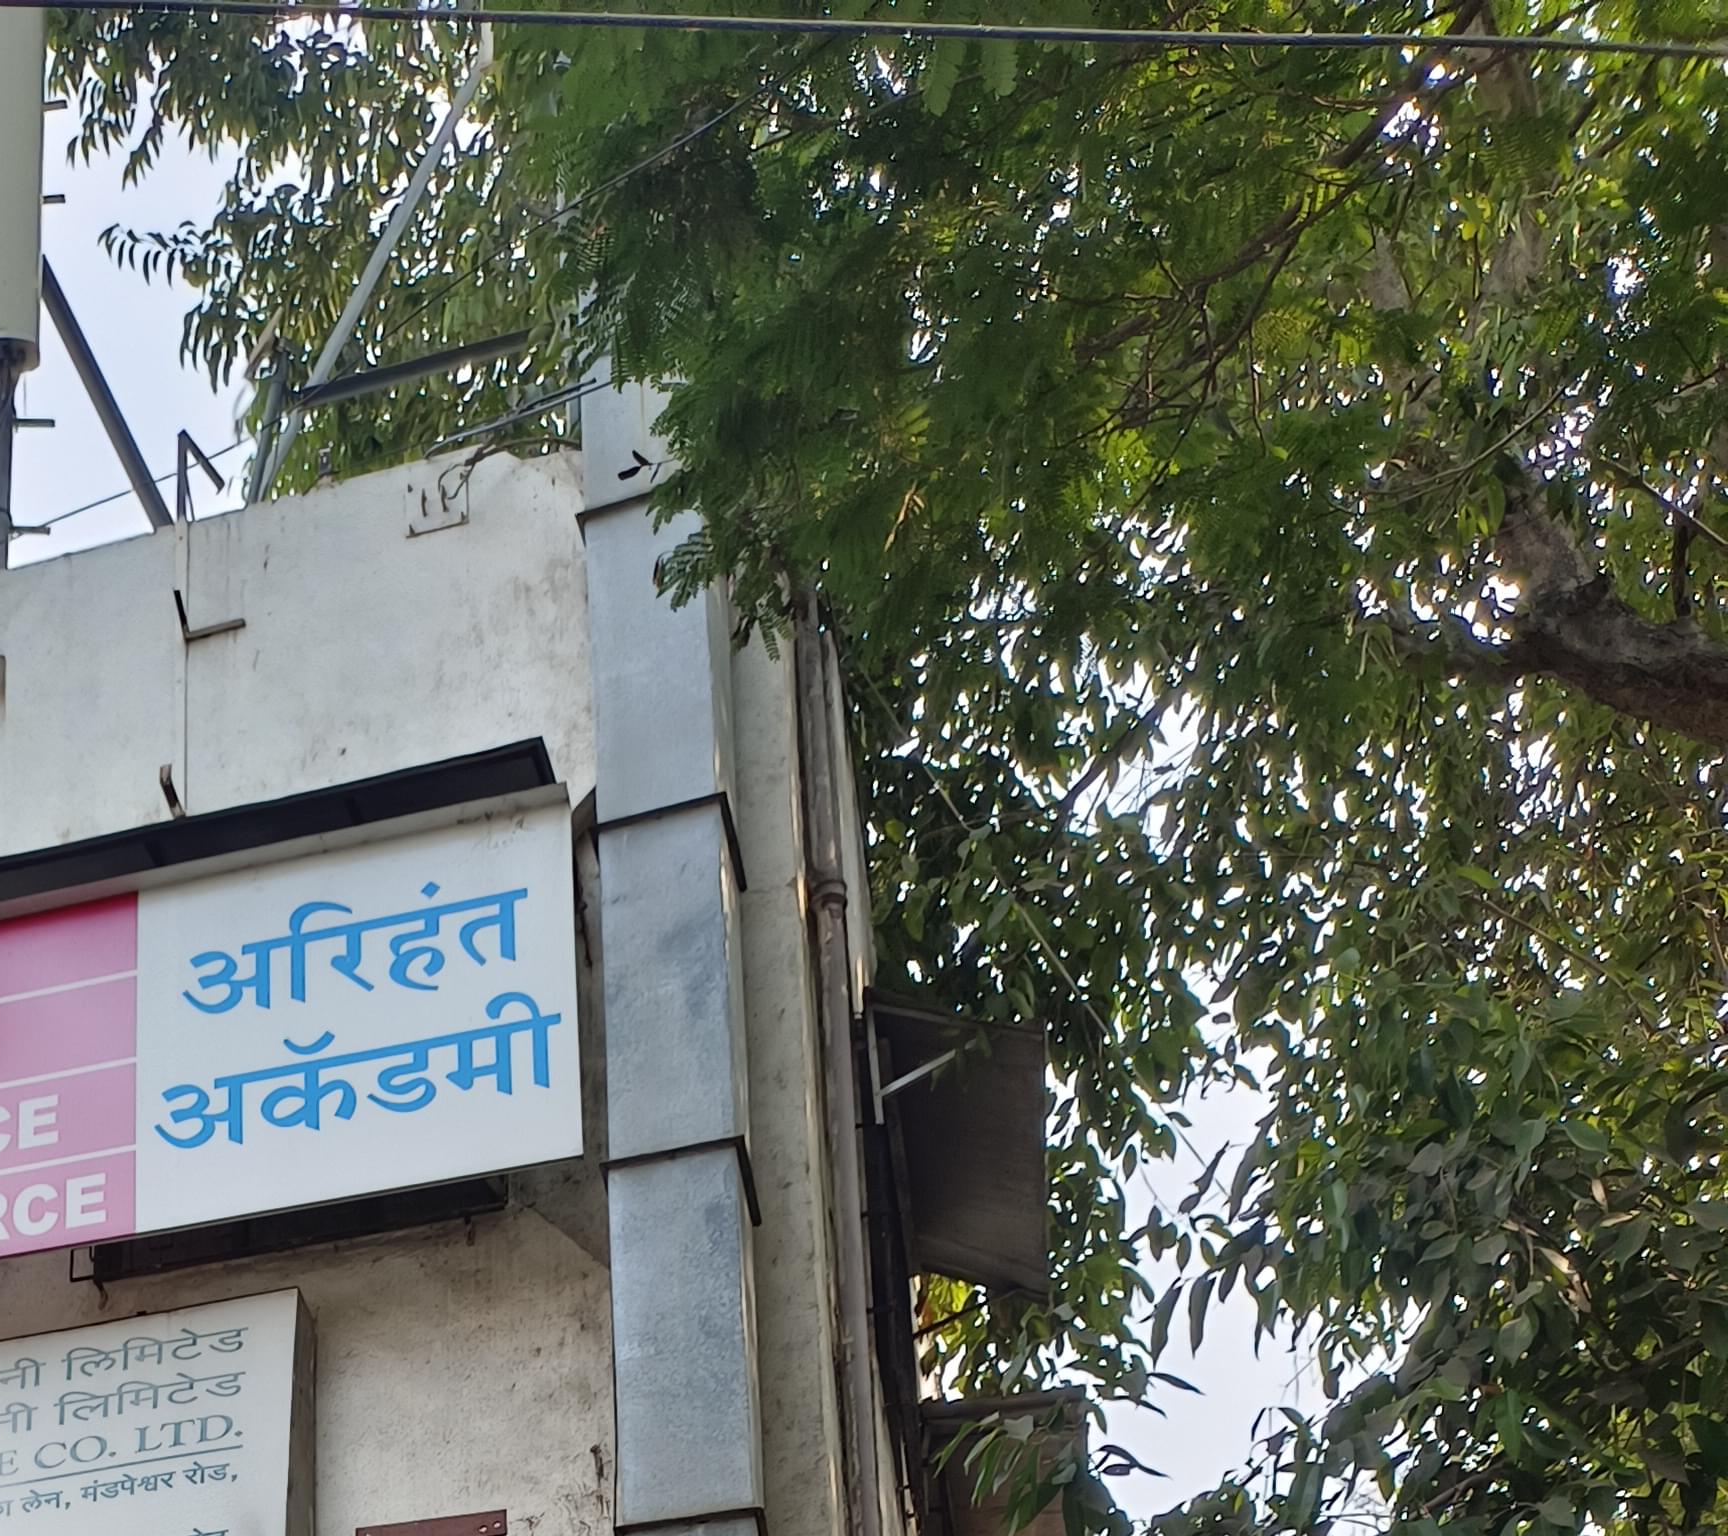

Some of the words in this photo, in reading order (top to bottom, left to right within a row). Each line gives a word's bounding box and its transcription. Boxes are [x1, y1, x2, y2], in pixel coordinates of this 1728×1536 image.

[181, 880, 529, 1016] अरिहंत
[153, 991, 562, 1150] अकॅडमी
[61, 1327, 249, 1381] लिमिटेड
[53, 1371, 247, 1426] लिमिटेड
[33, 1434, 118, 1470] CO.
[134, 1413, 245, 1455] LTD.
[21, 1488, 72, 1515] लेन,
[79, 1468, 178, 1502] मंडपेश्वर
[182, 1459, 239, 1486] रोड,
